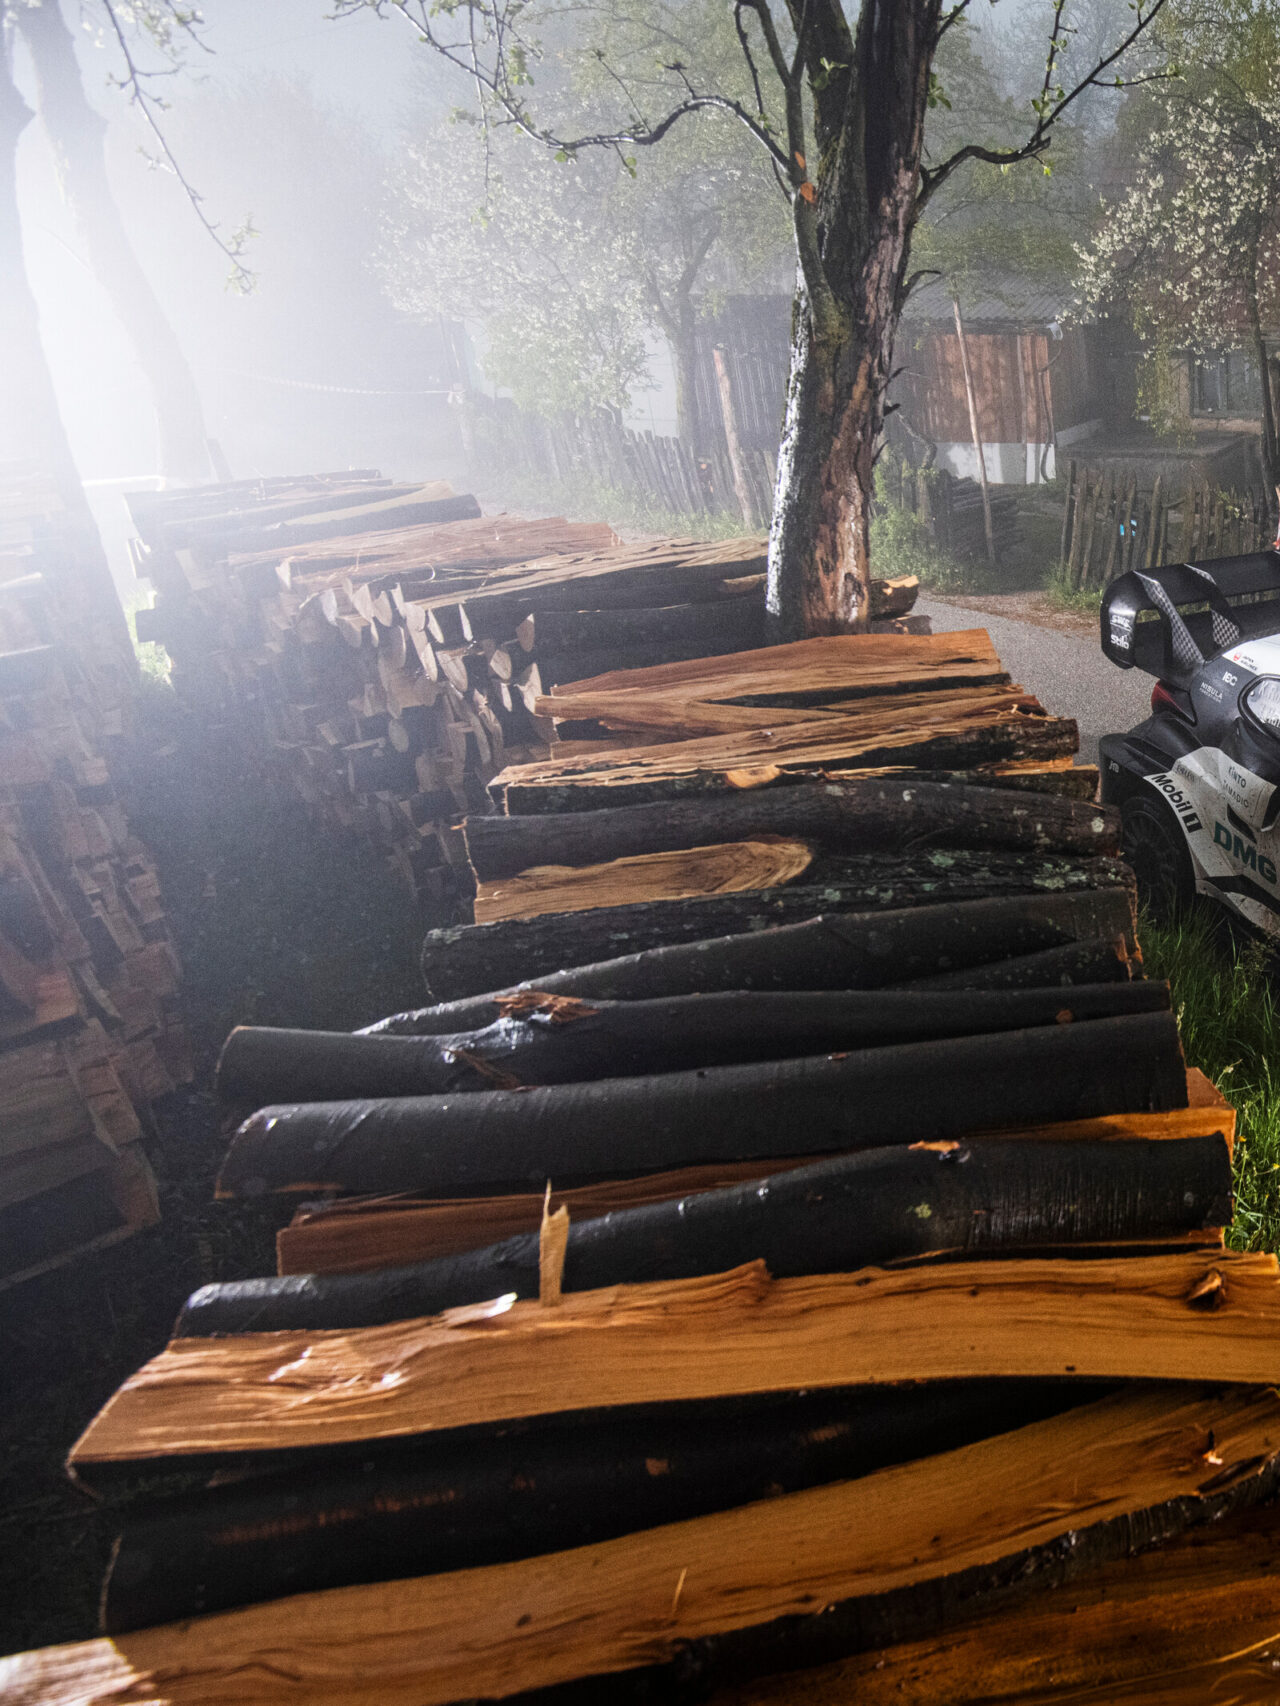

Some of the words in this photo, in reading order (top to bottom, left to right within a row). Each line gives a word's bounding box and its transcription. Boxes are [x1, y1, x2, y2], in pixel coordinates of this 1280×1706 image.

[1201, 682, 1223, 700] NISULA
[1151, 774, 1193, 813] Mobil
[1213, 820, 1277, 885] DMG
